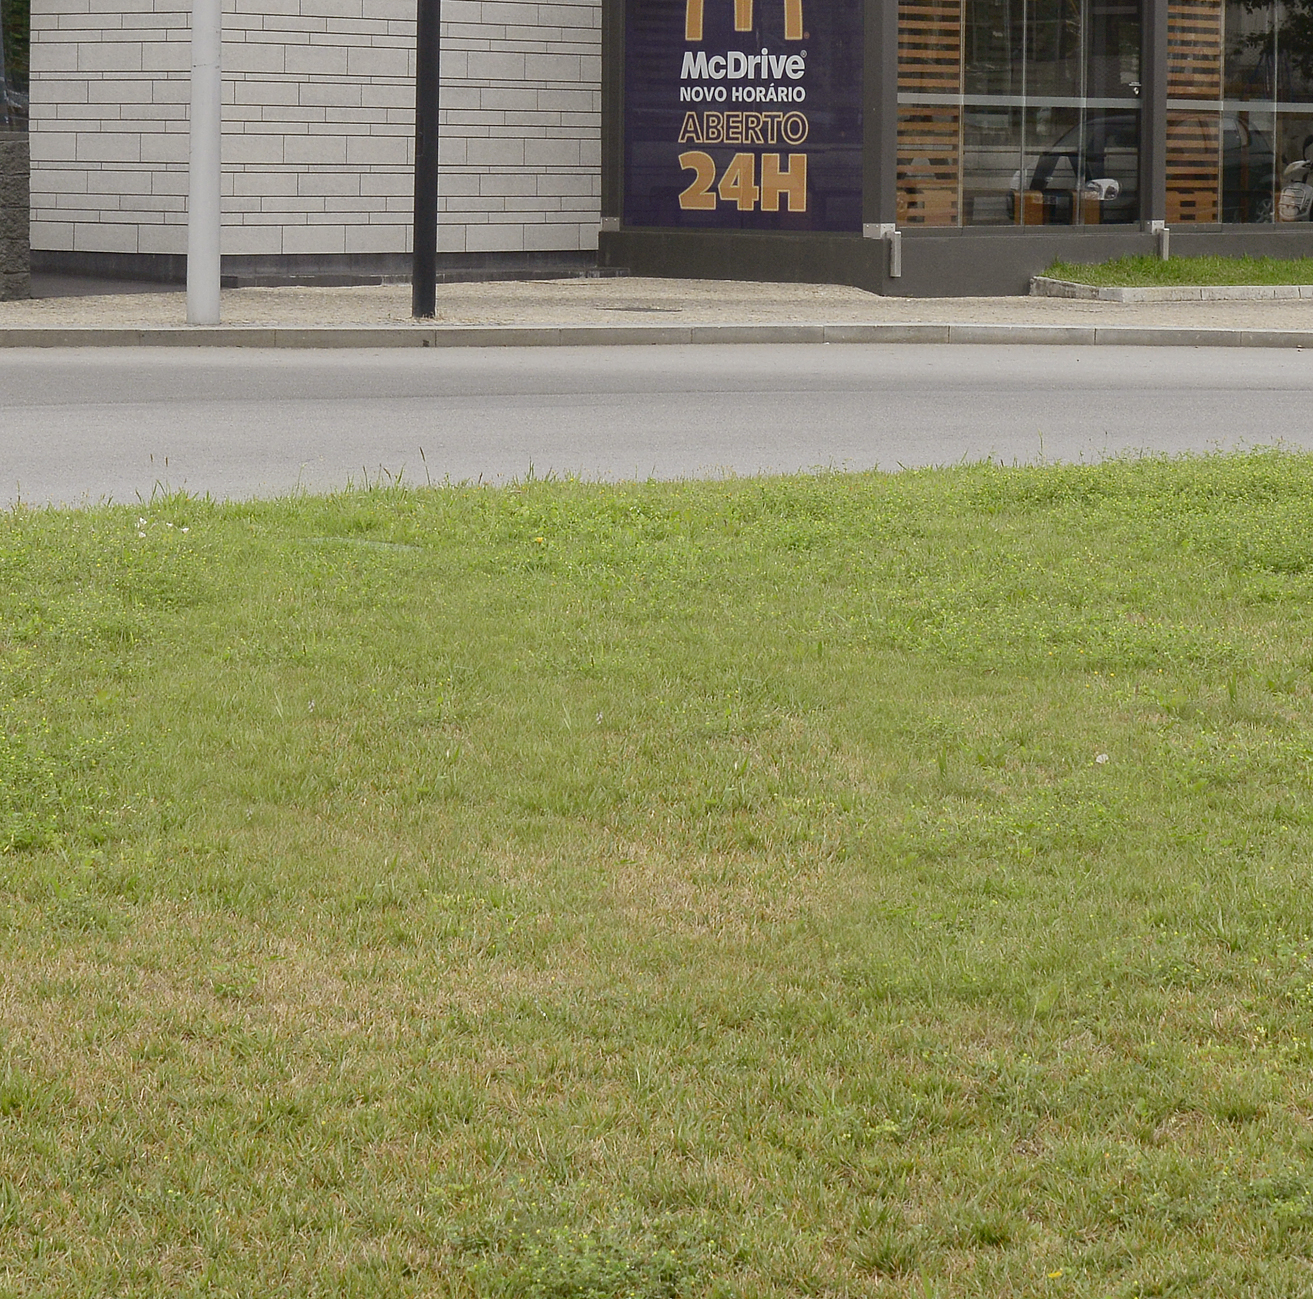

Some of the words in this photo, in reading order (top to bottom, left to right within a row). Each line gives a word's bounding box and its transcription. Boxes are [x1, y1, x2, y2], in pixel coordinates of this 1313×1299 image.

[679, 86, 727, 102] NOVO
[731, 82, 806, 102] HORÁRIO
[678, 111, 809, 145] ABERTO
[678, 150, 807, 212] 24H
